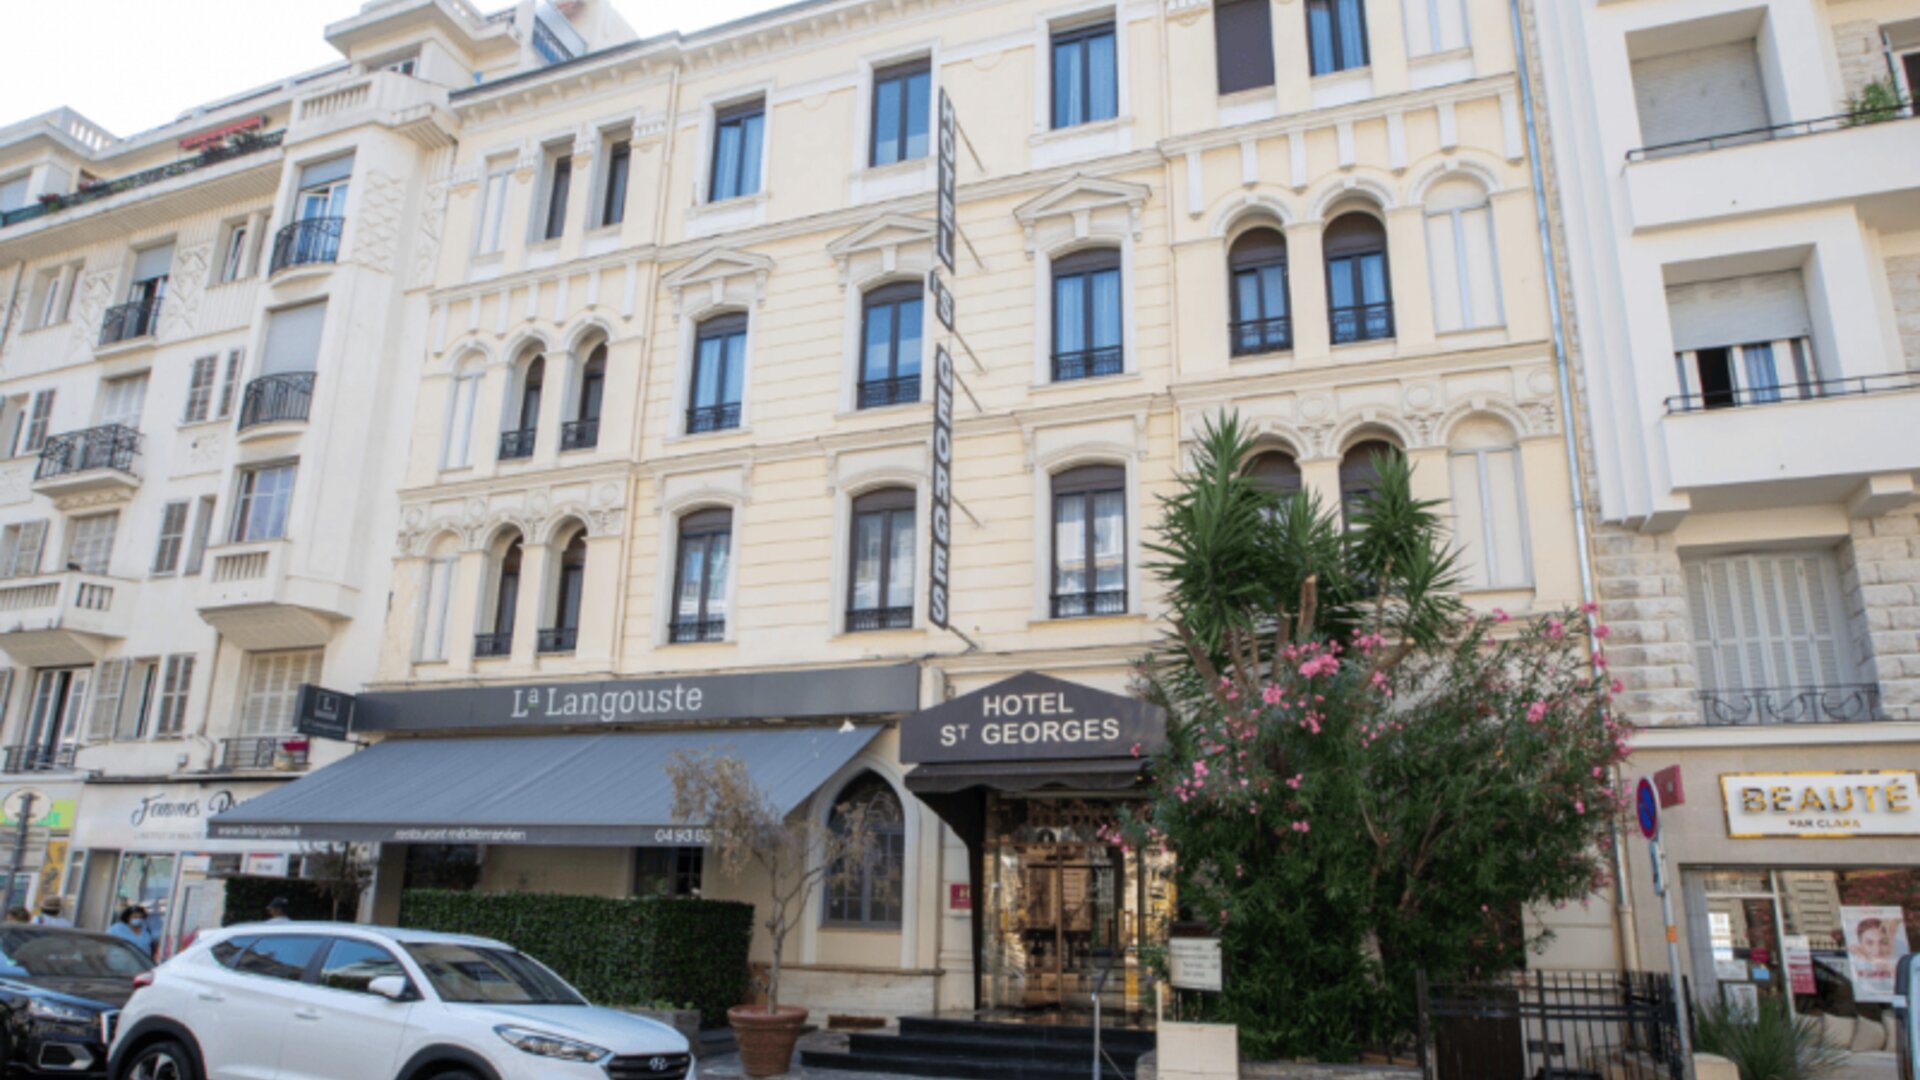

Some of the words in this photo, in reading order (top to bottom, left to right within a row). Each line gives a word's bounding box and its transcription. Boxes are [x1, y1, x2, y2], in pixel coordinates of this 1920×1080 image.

[941, 90, 954, 267] HOTEL
[932, 348, 951, 624] GEORGES
[511, 687, 539, 718] La
[545, 683, 702, 722] Langouste
[983, 692, 1074, 718] HOTEL
[981, 717, 1120, 745] GEORGES
[1742, 778, 1912, 813] BEAUTÉ
[655, 828, 673, 843] 04
[1816, 819, 1861, 828] CLARA
